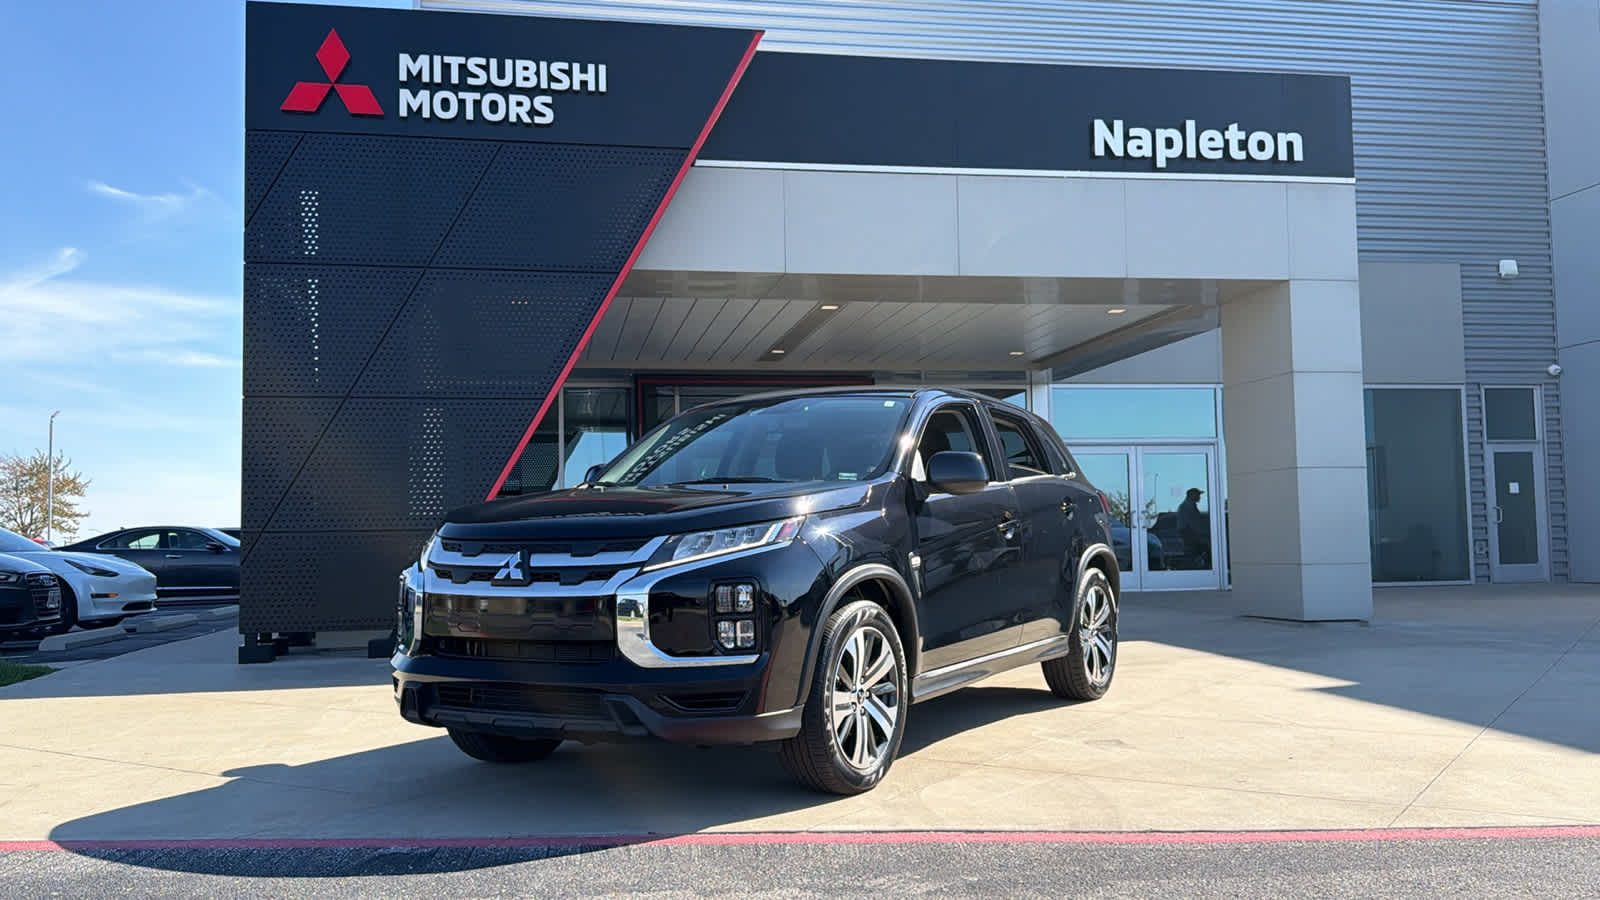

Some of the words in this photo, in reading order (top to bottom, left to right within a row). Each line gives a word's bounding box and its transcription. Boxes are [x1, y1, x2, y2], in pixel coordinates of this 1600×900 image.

[398, 53, 608, 93] MITSUBISHI
[398, 88, 555, 126] MOTORS
[1093, 118, 1305, 169] Napleton
